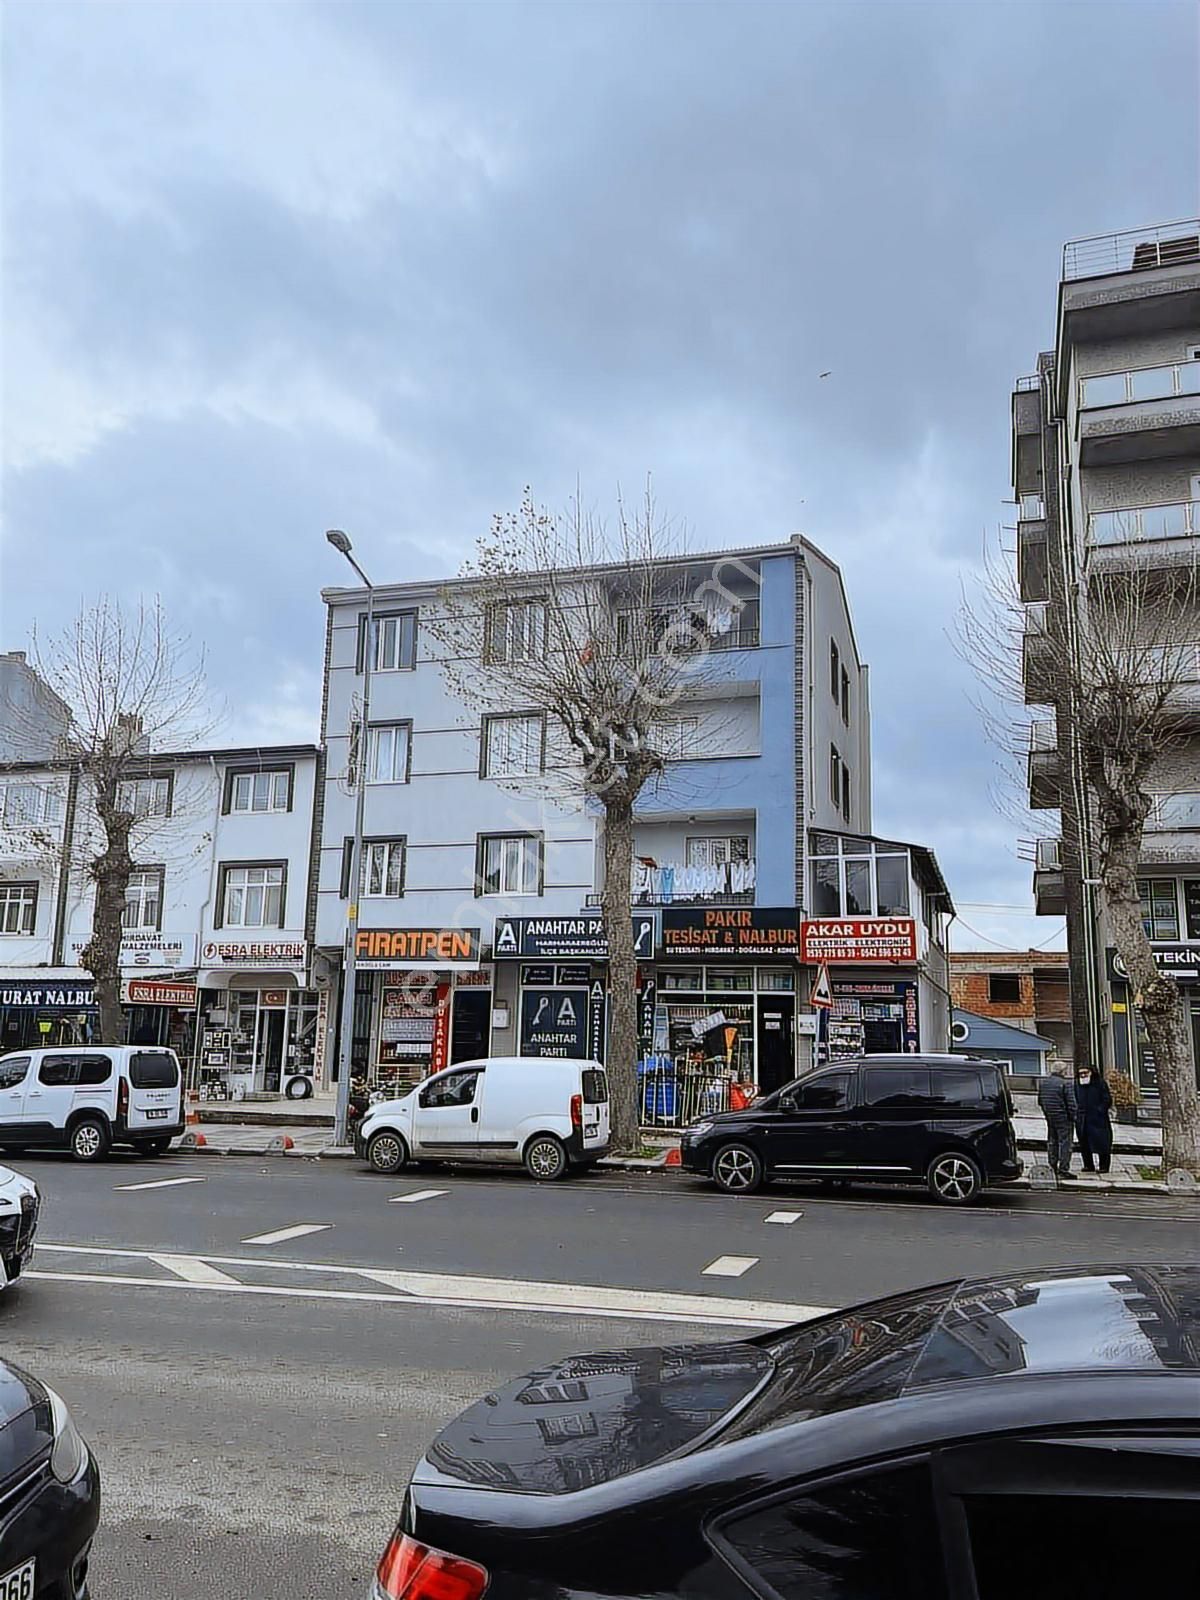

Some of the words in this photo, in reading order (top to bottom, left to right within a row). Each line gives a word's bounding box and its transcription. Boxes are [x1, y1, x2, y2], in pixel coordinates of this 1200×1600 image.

[705, 911, 752, 926] PAKIR
[498, 923, 516, 944] A
[526, 920, 585, 935] ANAHTAR
[664, 926, 719, 944] TESİSAT
[724, 931, 734, 944] &
[739, 929, 797, 944] NALBUR
[806, 925, 854, 936] AKAR
[860, 923, 911, 935] UYDU
[121, 940, 182, 950] MALZEMELERİ
[218, 944, 247, 955] ESRA
[356, 932, 471, 957] FIRATPEN
[0, 990, 42, 1005] URAT
[45, 990, 99, 1005] NALBU
[133, 987, 155, 1001] ESRA
[558, 997, 577, 1019] A
[530, 1033, 578, 1043] ANAHTAR
